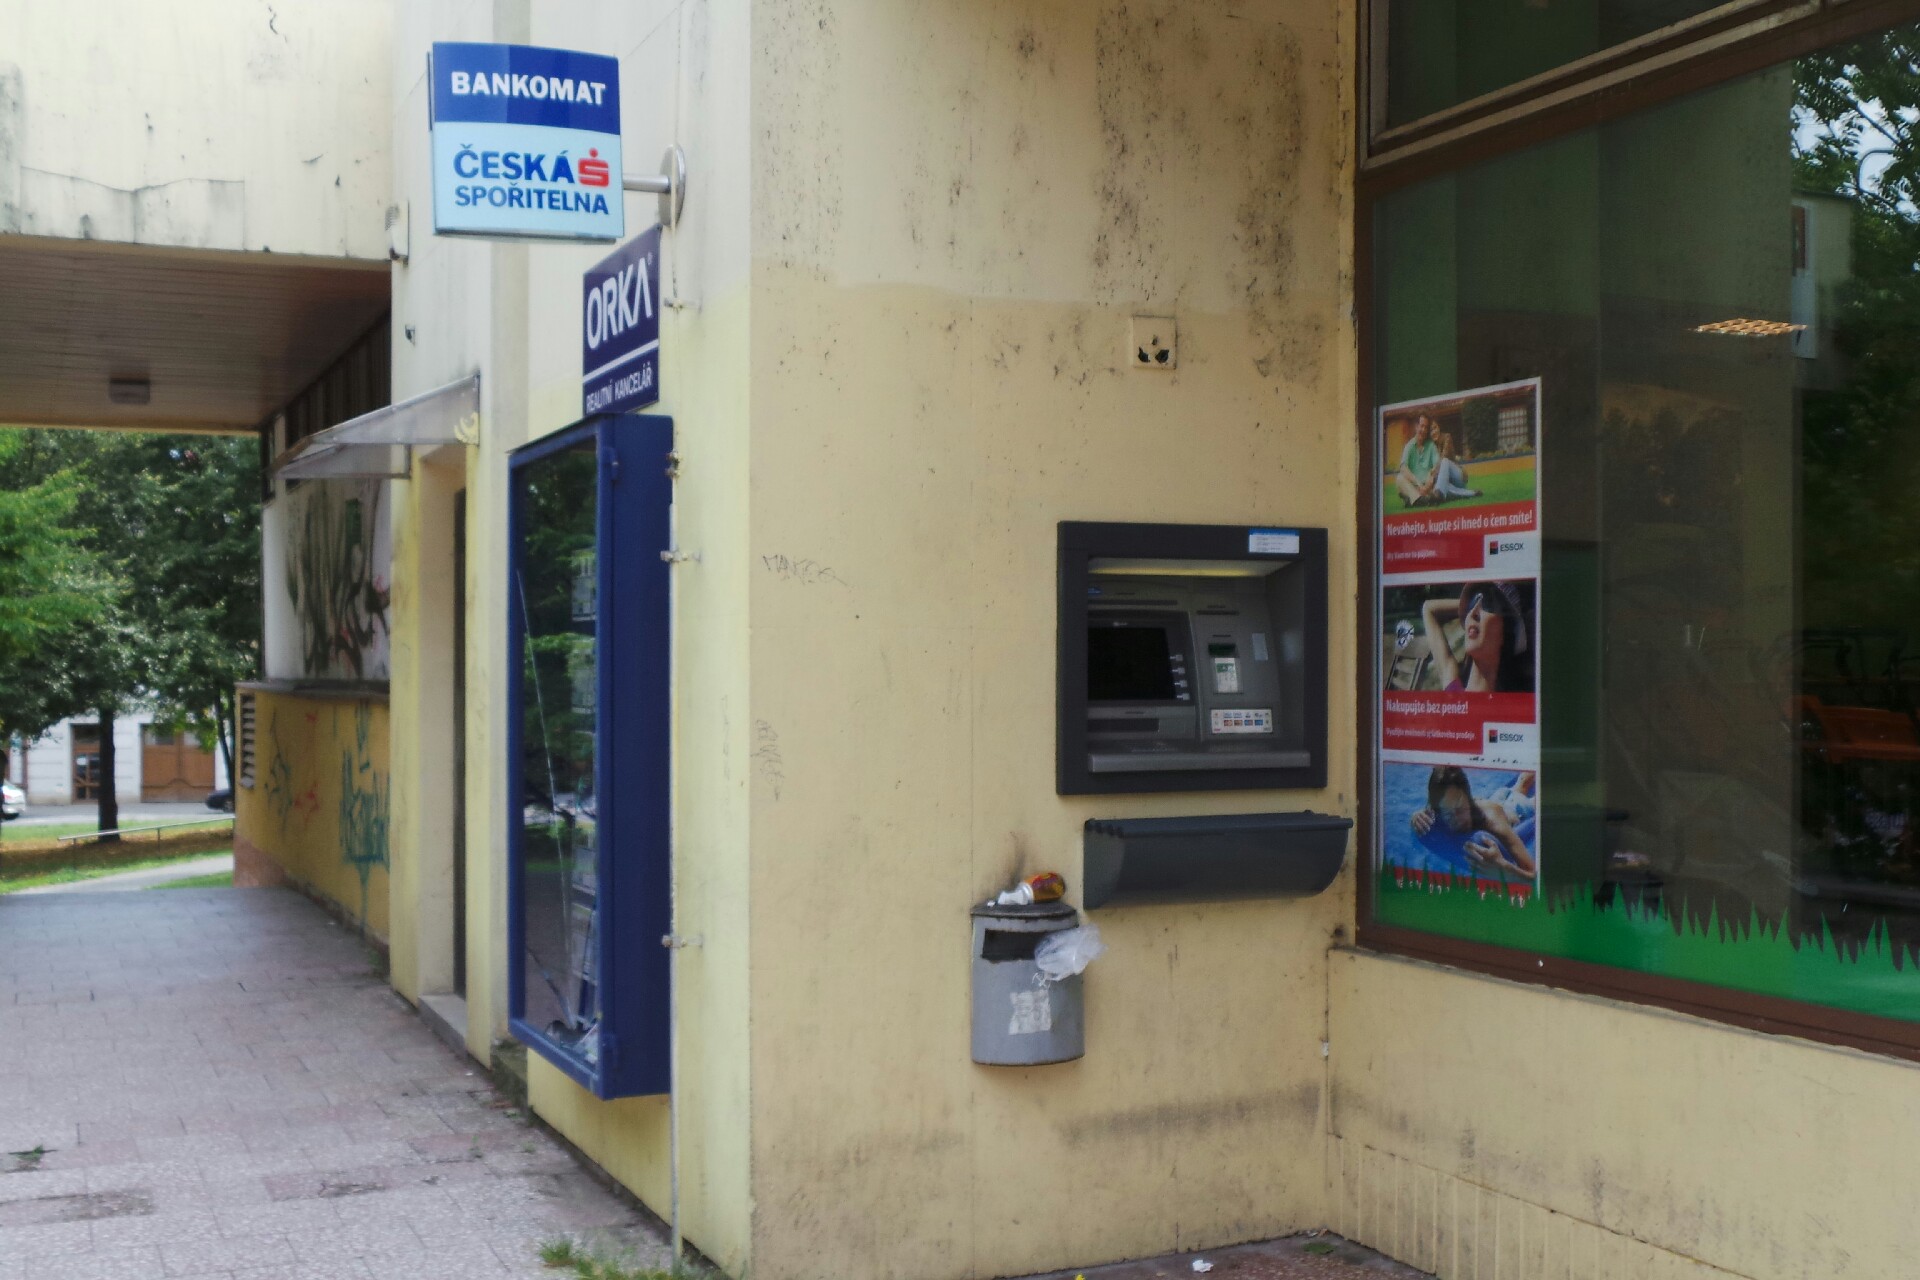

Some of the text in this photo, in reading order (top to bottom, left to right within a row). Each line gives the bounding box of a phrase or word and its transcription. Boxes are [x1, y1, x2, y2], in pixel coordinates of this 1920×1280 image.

[451, 71, 606, 106] BANKOMAT
[453, 143, 575, 184] ČESKÁ
[455, 183, 609, 215] SPOŘITELNA
[586, 362, 652, 415] REALITNÍ KANCELÁŘ
[1428, 519, 1452, 535] kupte
[1453, 517, 1460, 530] si
[1461, 515, 1481, 530] hned
[1509, 509, 1533, 525] sníte!
[1500, 543, 1524, 552] ESSOX
[1386, 699, 1425, 715] Nakupujte
[1426, 701, 1440, 713] bez
[1500, 733, 1524, 742] ESSOX
